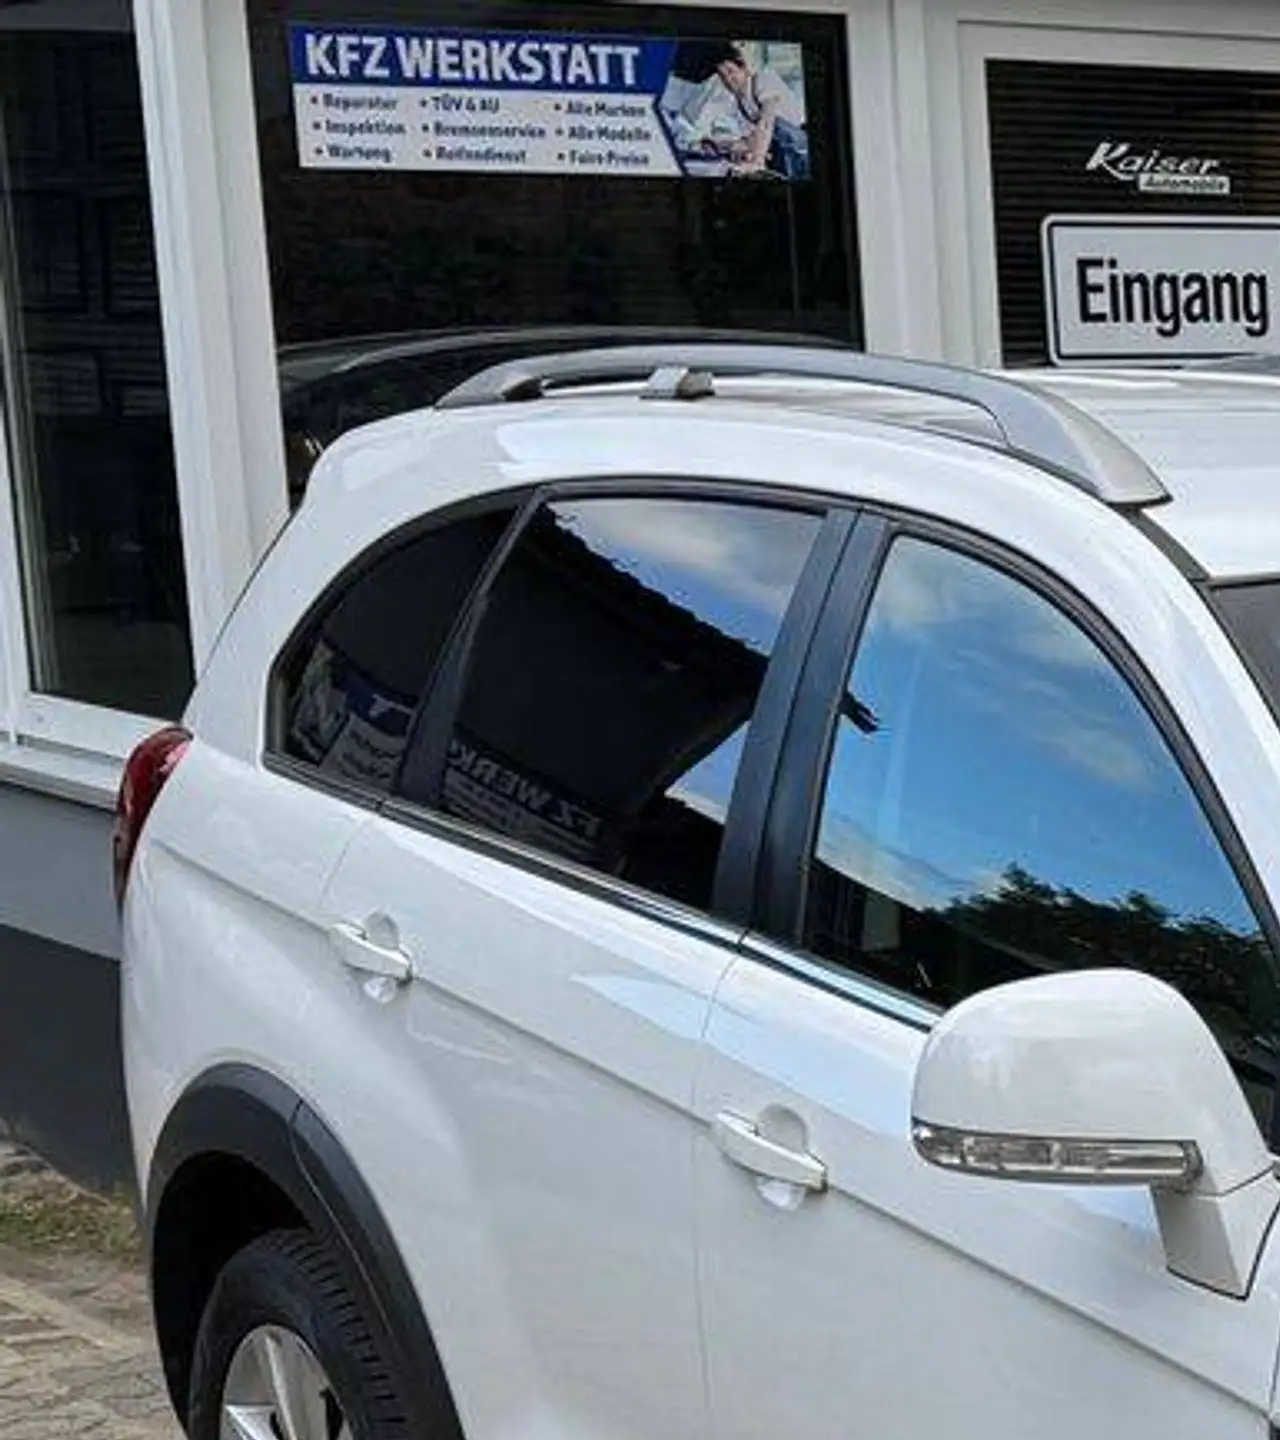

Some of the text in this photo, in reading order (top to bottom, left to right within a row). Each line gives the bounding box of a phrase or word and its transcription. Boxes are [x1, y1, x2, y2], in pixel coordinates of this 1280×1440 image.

[304, 33, 640, 85] KFZ WERKSTATT
[1086, 142, 1221, 181] Kaiser
[1076, 257, 1269, 337] Eingang
